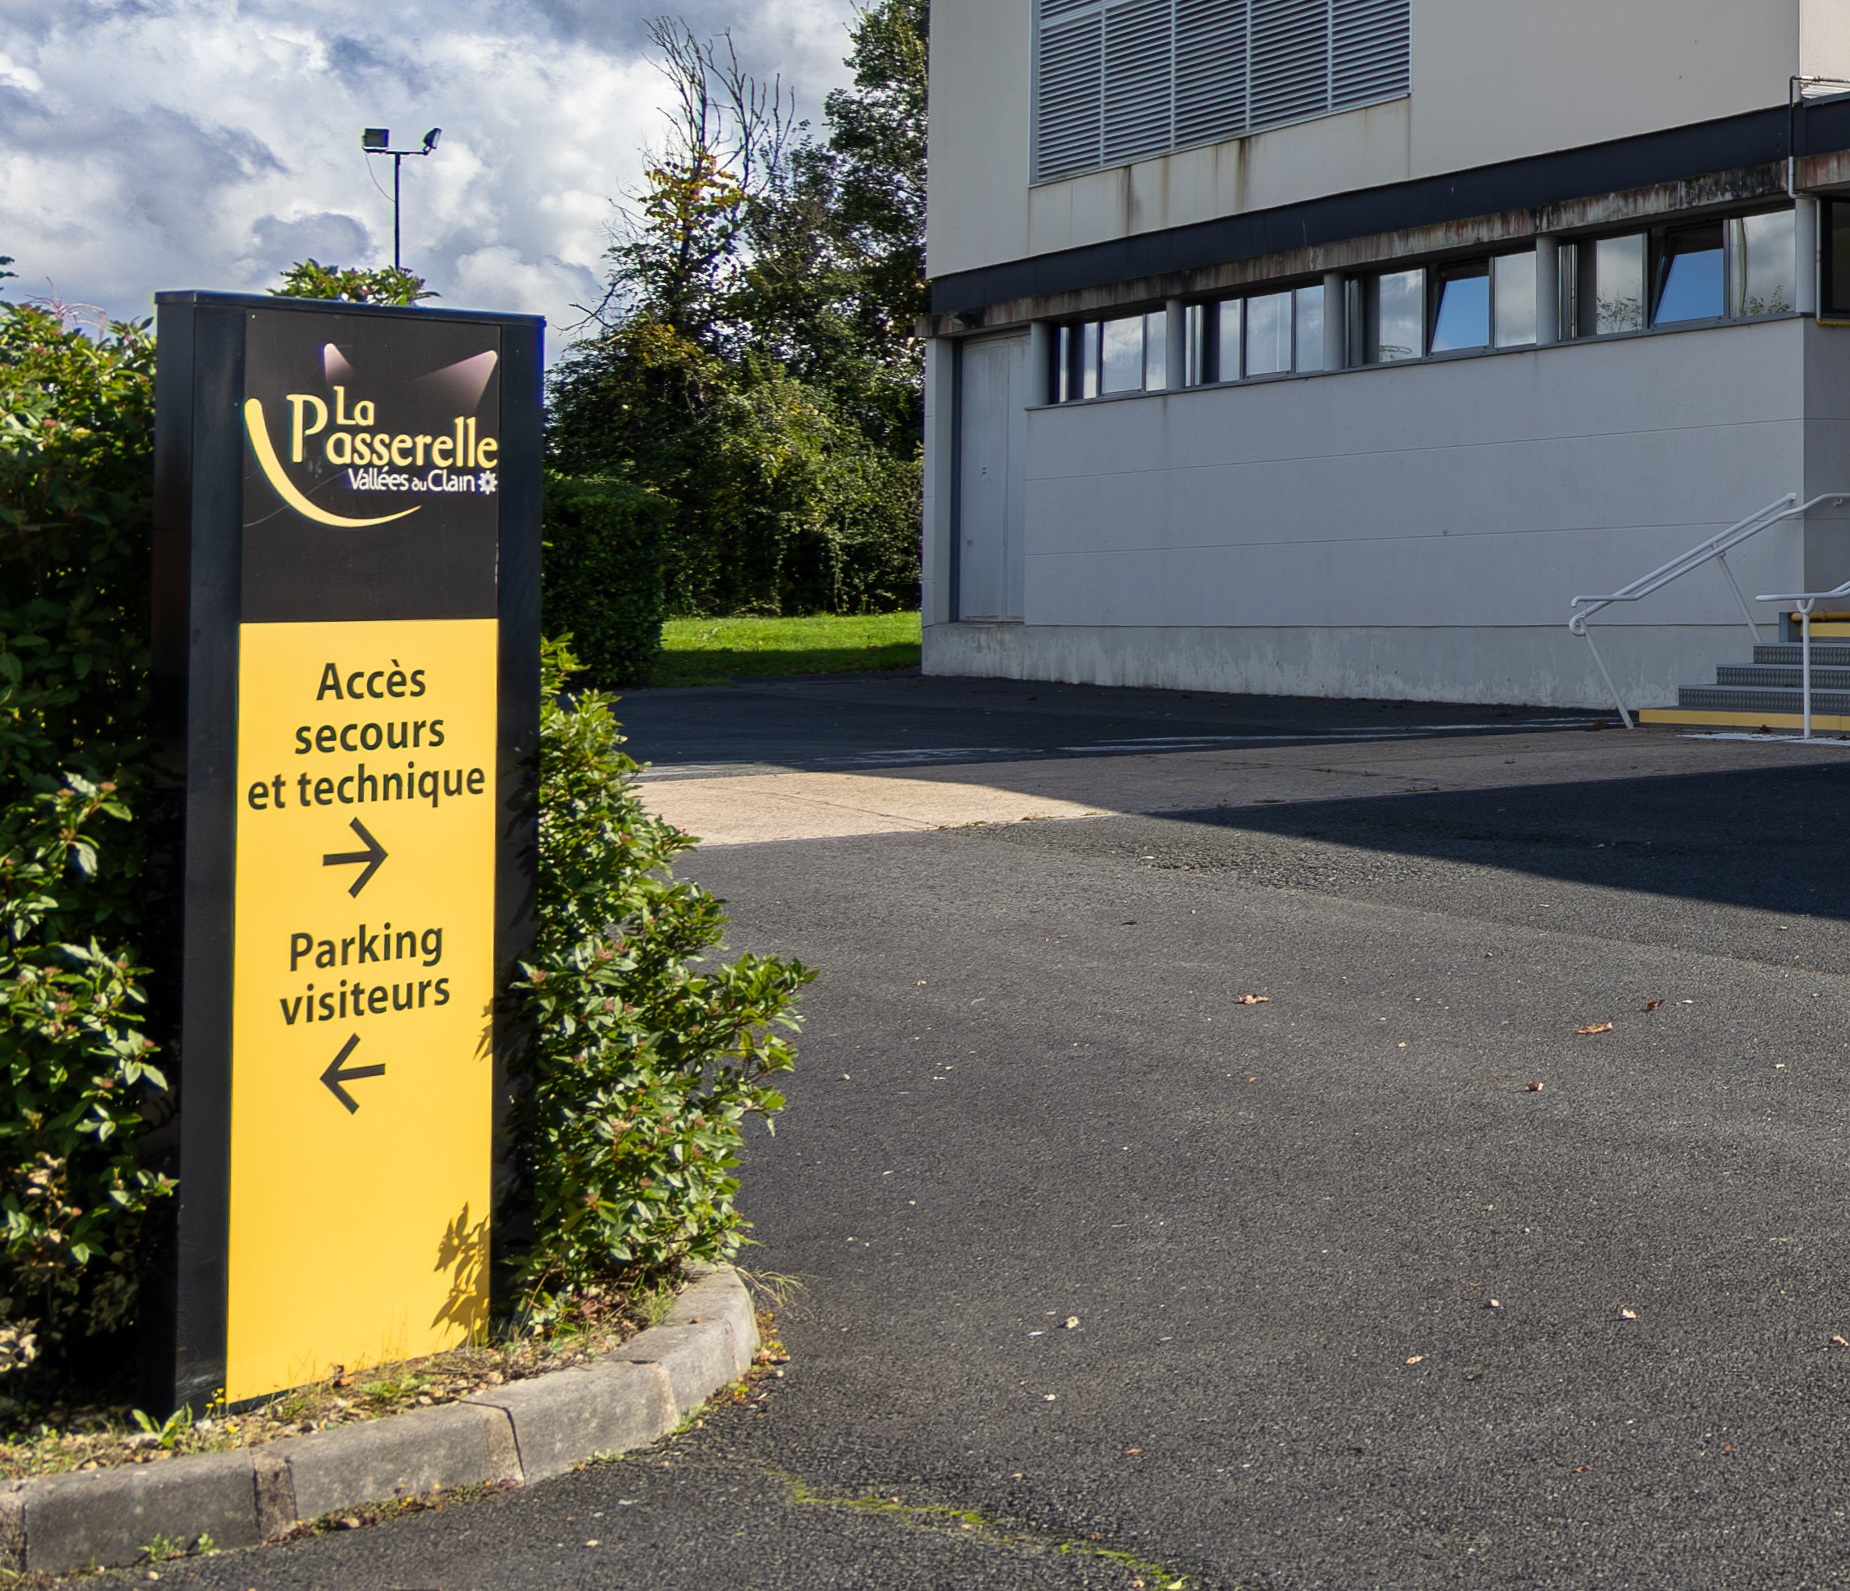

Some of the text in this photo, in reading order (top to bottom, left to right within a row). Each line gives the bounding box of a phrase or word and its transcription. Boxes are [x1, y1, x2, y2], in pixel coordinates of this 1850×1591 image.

[334, 387, 375, 426] La
[286, 394, 499, 469] Passerelle
[347, 465, 475, 493] Vallées au Clain
[316, 658, 427, 703] Accès
[294, 717, 445, 756] secours
[247, 761, 486, 811] et technique
[289, 922, 444, 972] Parking
[279, 972, 450, 1027] visiteurs
